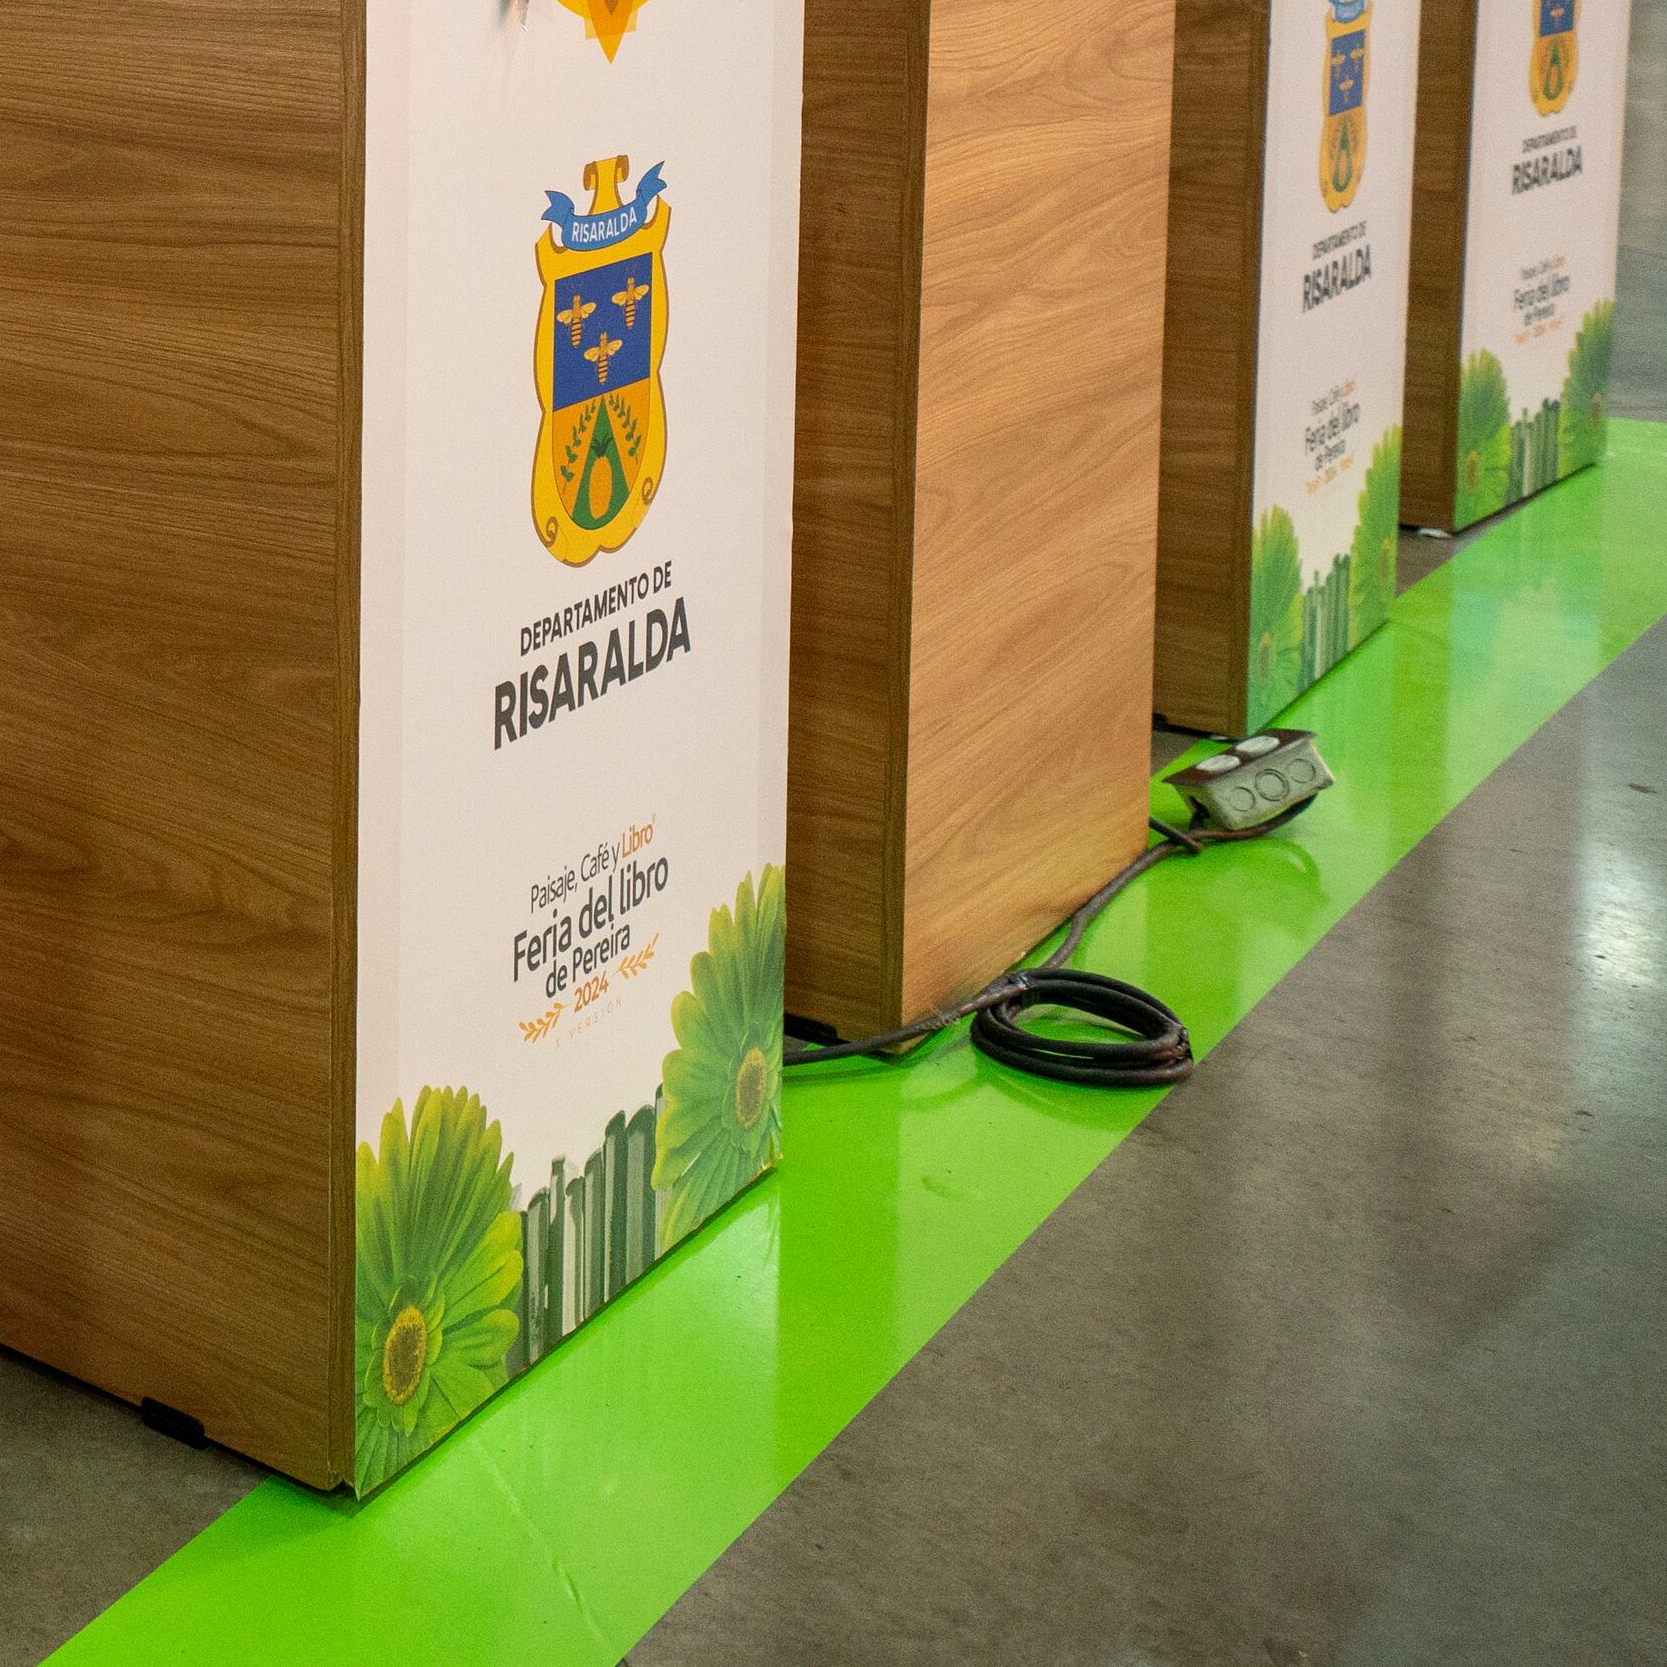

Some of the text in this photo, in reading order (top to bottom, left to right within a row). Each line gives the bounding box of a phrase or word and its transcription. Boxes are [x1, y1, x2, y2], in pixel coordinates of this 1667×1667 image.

[1512, 146, 1582, 196] RISARALDA
[571, 203, 639, 244] RISARALDA
[1303, 243, 1371, 313] RISARALDA
[520, 560, 672, 656] DEPARTAMENTO DE
[493, 596, 691, 752] RISARALDA
[530, 823, 654, 914] Paisaje, Café y Libro
[513, 856, 668, 983] Feria del libro
[545, 923, 630, 999] de Pereira
[573, 971, 609, 1014] 2024
